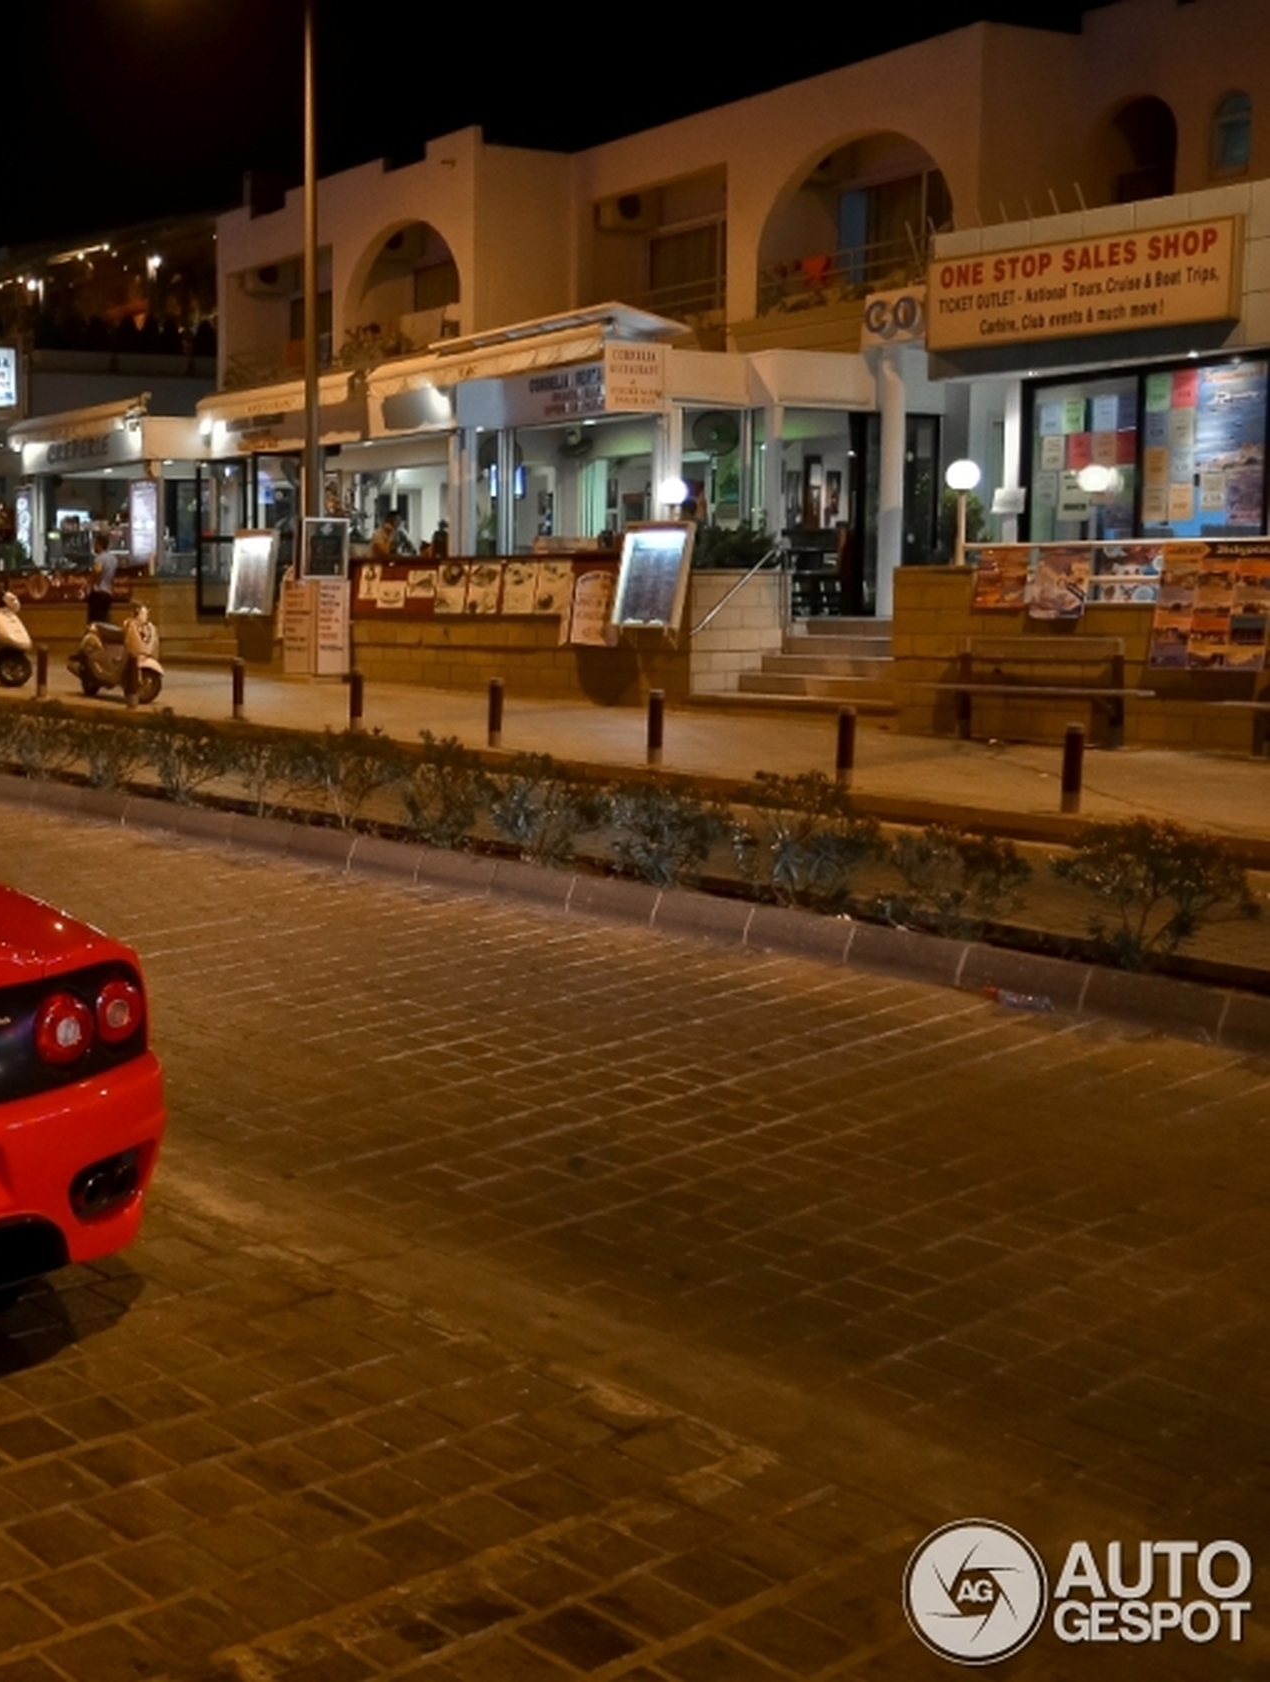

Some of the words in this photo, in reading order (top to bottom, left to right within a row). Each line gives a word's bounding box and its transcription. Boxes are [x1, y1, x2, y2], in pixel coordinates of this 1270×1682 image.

[940, 262, 984, 289] ONE
[993, 253, 1052, 282] STOP
[1062, 240, 1137, 273] SALES
[1147, 227, 1218, 261] SHOP
[939, 295, 973, 314] TICKET
[976, 289, 1015, 310] OUTLET
[1024, 284, 1068, 304] National
[1143, 273, 1152, 288] &
[1155, 268, 1181, 288] Boat
[1022, 313, 1045, 331] Club
[1049, 310, 1083, 328] events
[1086, 307, 1093, 323] &
[1096, 301, 1126, 322] much
